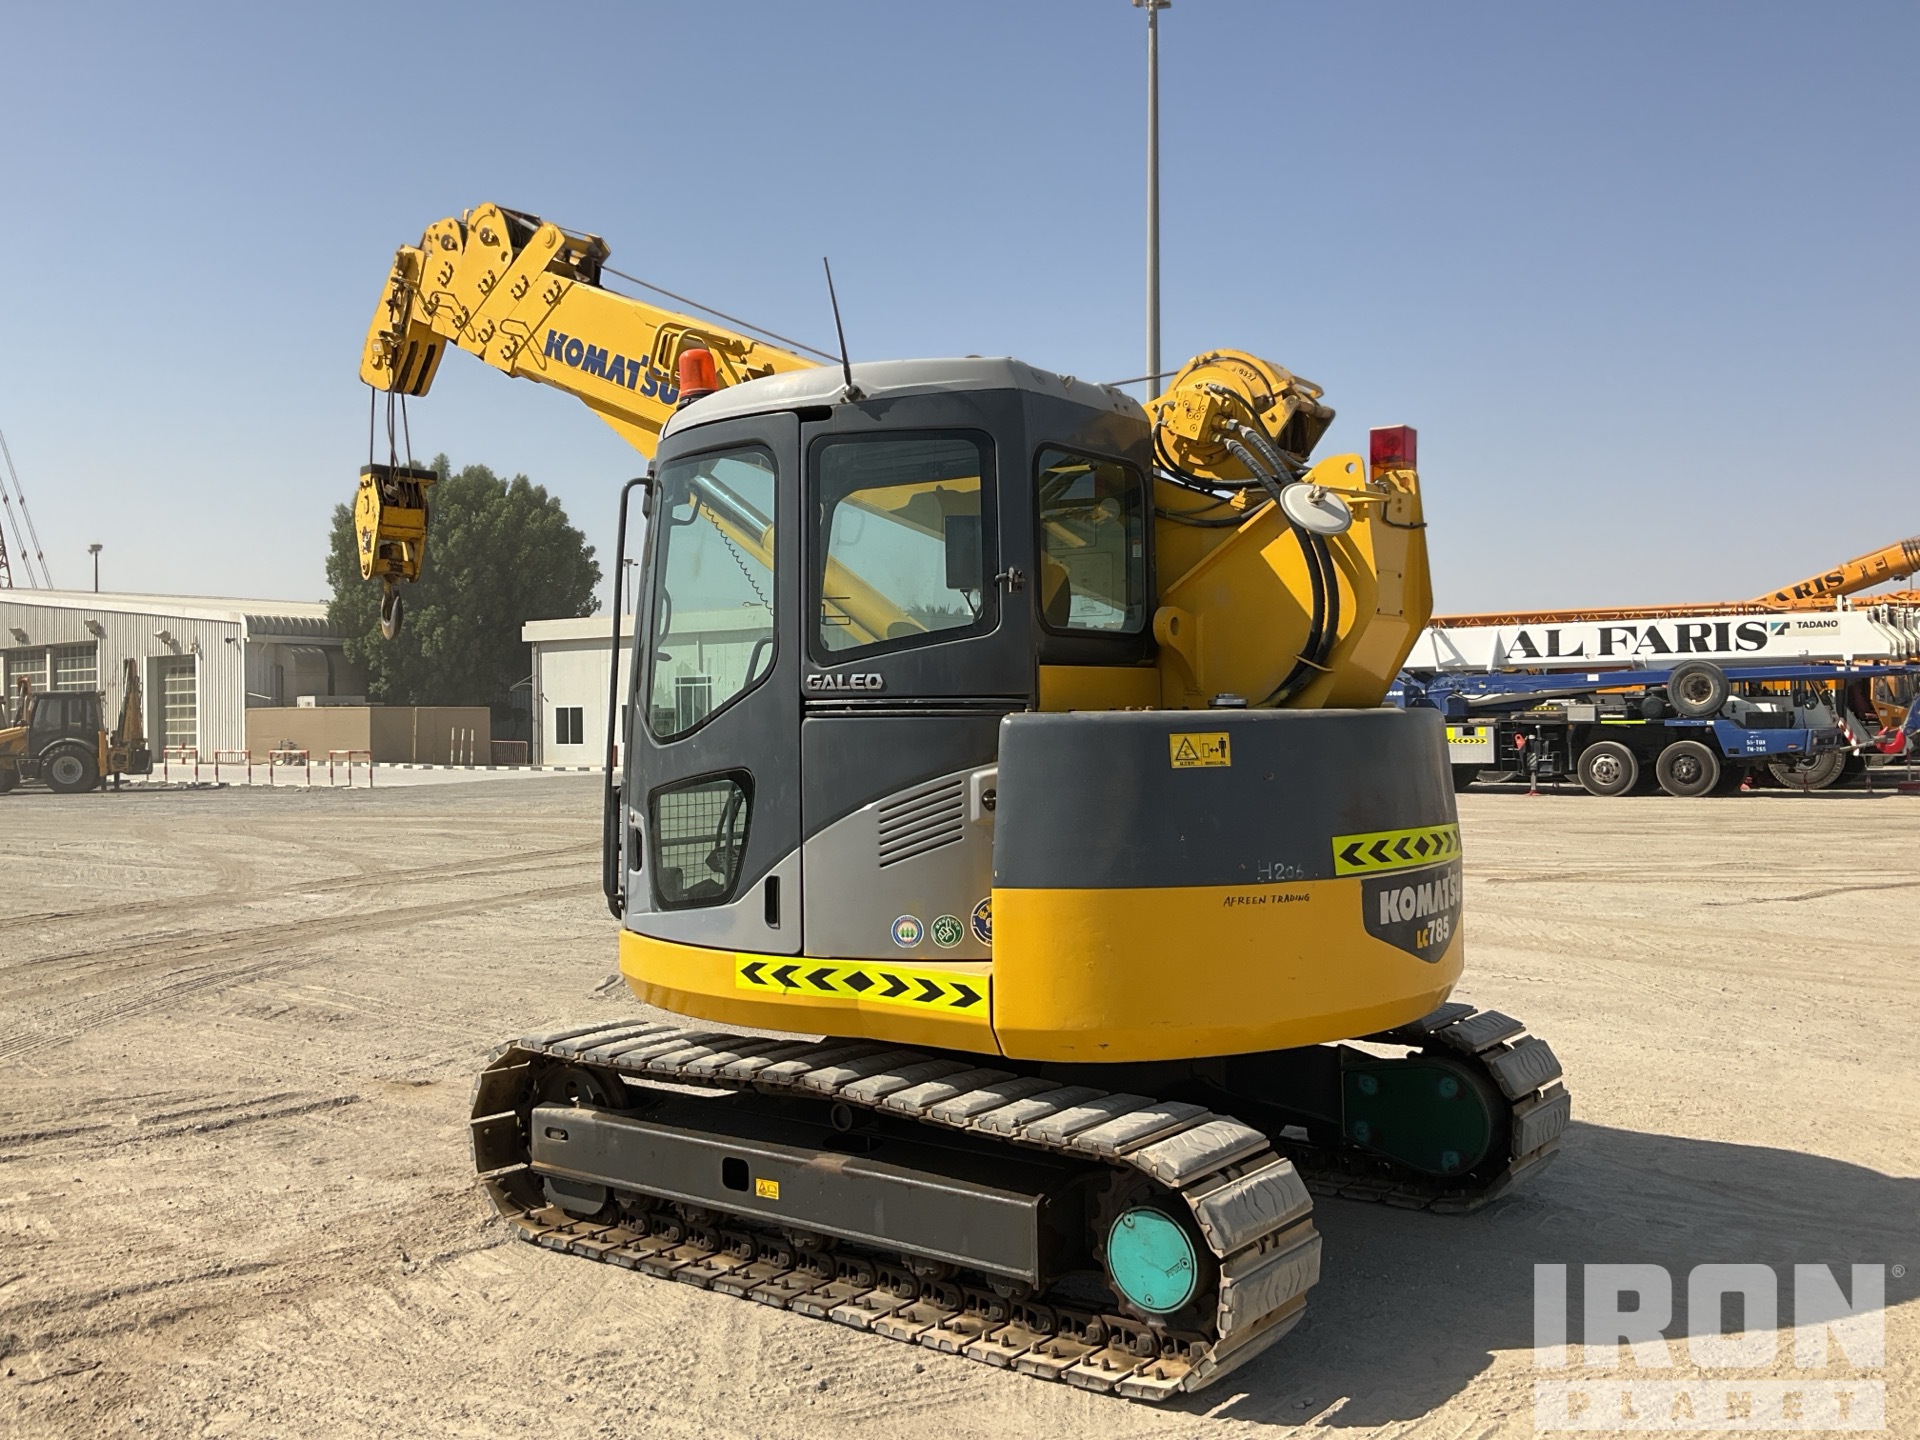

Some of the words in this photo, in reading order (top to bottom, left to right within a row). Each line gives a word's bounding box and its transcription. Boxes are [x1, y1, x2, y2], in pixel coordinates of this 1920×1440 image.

[544, 328, 680, 406] KOMATSU
[1796, 619, 1839, 629] TADANO
[1503, 629, 1584, 659] AL
[1597, 621, 1768, 655] FARIS
[806, 673, 884, 691] GALEO
[1223, 895, 1267, 907] AFREEN
[1271, 893, 1311, 905] TRADING
[1380, 867, 1461, 925] KOMATSU
